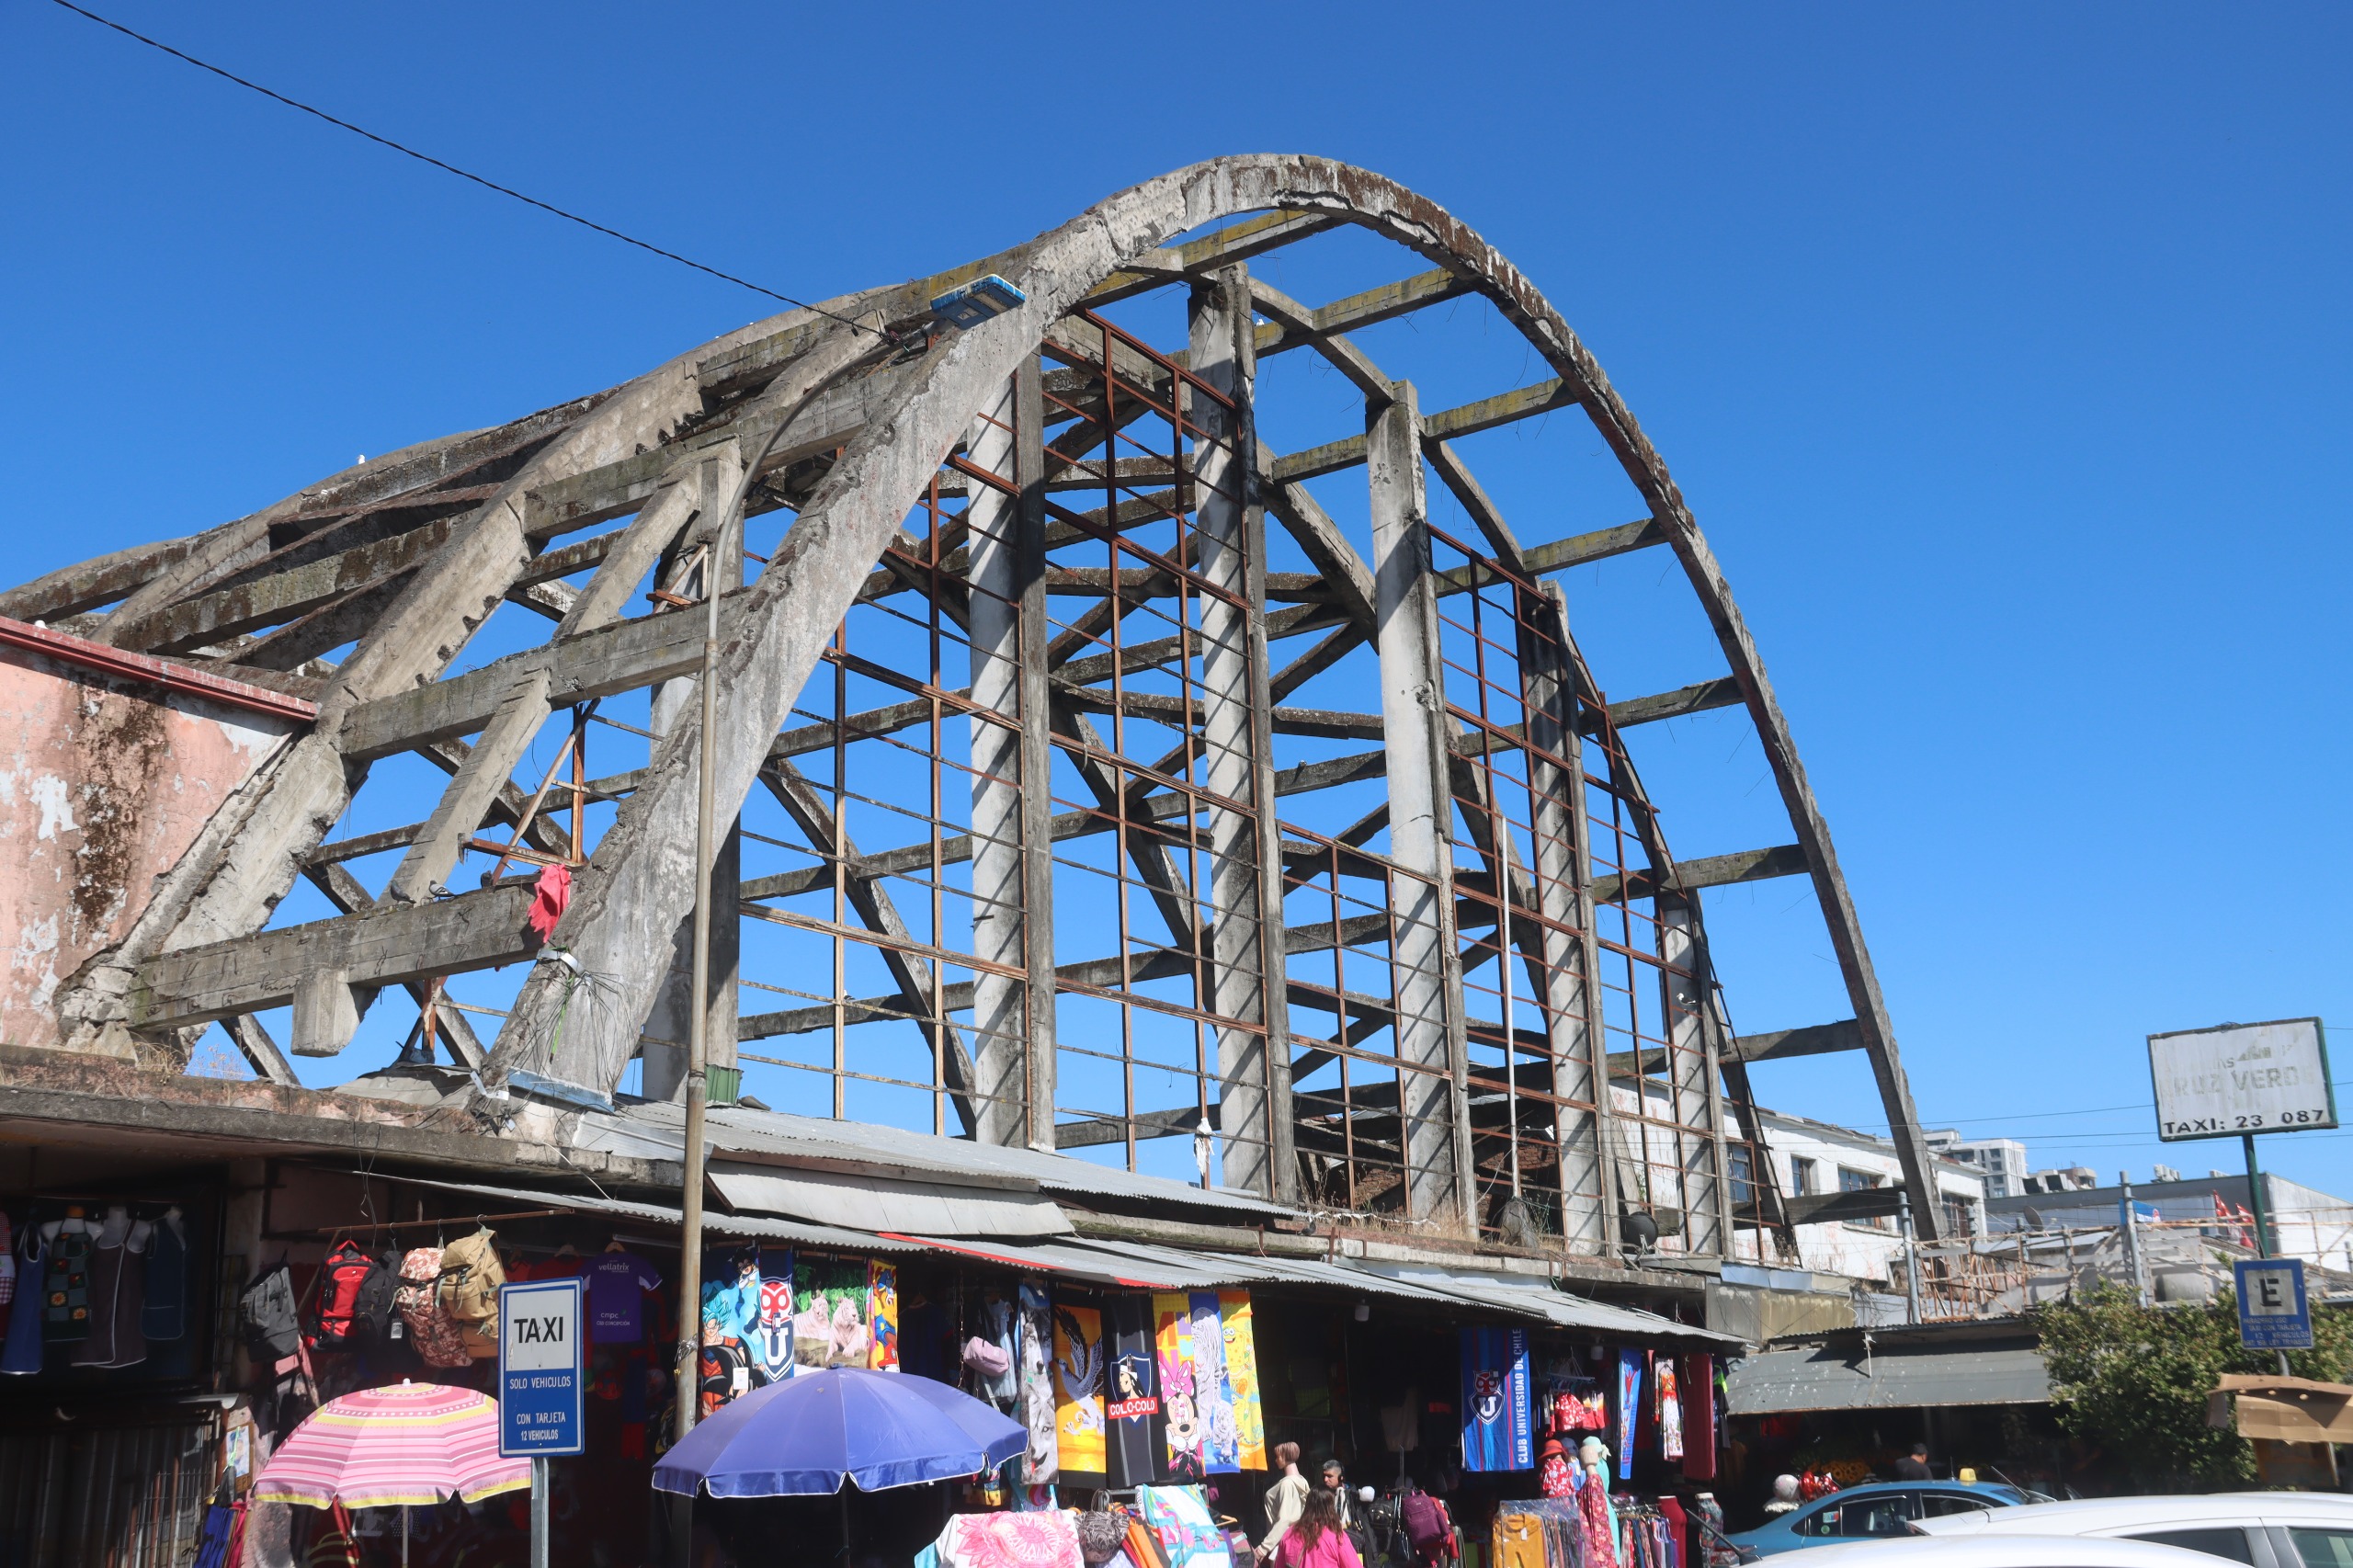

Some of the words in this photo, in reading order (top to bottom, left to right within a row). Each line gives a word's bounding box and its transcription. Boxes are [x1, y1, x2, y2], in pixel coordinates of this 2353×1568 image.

[2164, 1118, 2225, 1134] TAXI:
[2235, 1114, 2263, 1129] 23
[2280, 1109, 2324, 1124] 087
[2259, 1278, 2282, 1307] E
[513, 1316, 563, 1344] TAXI
[1512, 1327, 1523, 1356] CHILE
[762, 1327, 789, 1366] U
[1514, 1358, 1524, 1370] DE
[509, 1378, 528, 1390] SOLO
[531, 1376, 571, 1389] VEHICULOS
[1109, 1399, 1155, 1415] COLO-COLO
[1478, 1395, 1496, 1417] U
[1515, 1371, 1527, 1436] UNIVERSIDAD
[517, 1413, 531, 1426] CON
[536, 1412, 566, 1424] TARJETA
[520, 1430, 528, 1441] 12
[528, 1429, 559, 1441] VEHICULOS
[1518, 1438, 1529, 1464] CLUB
